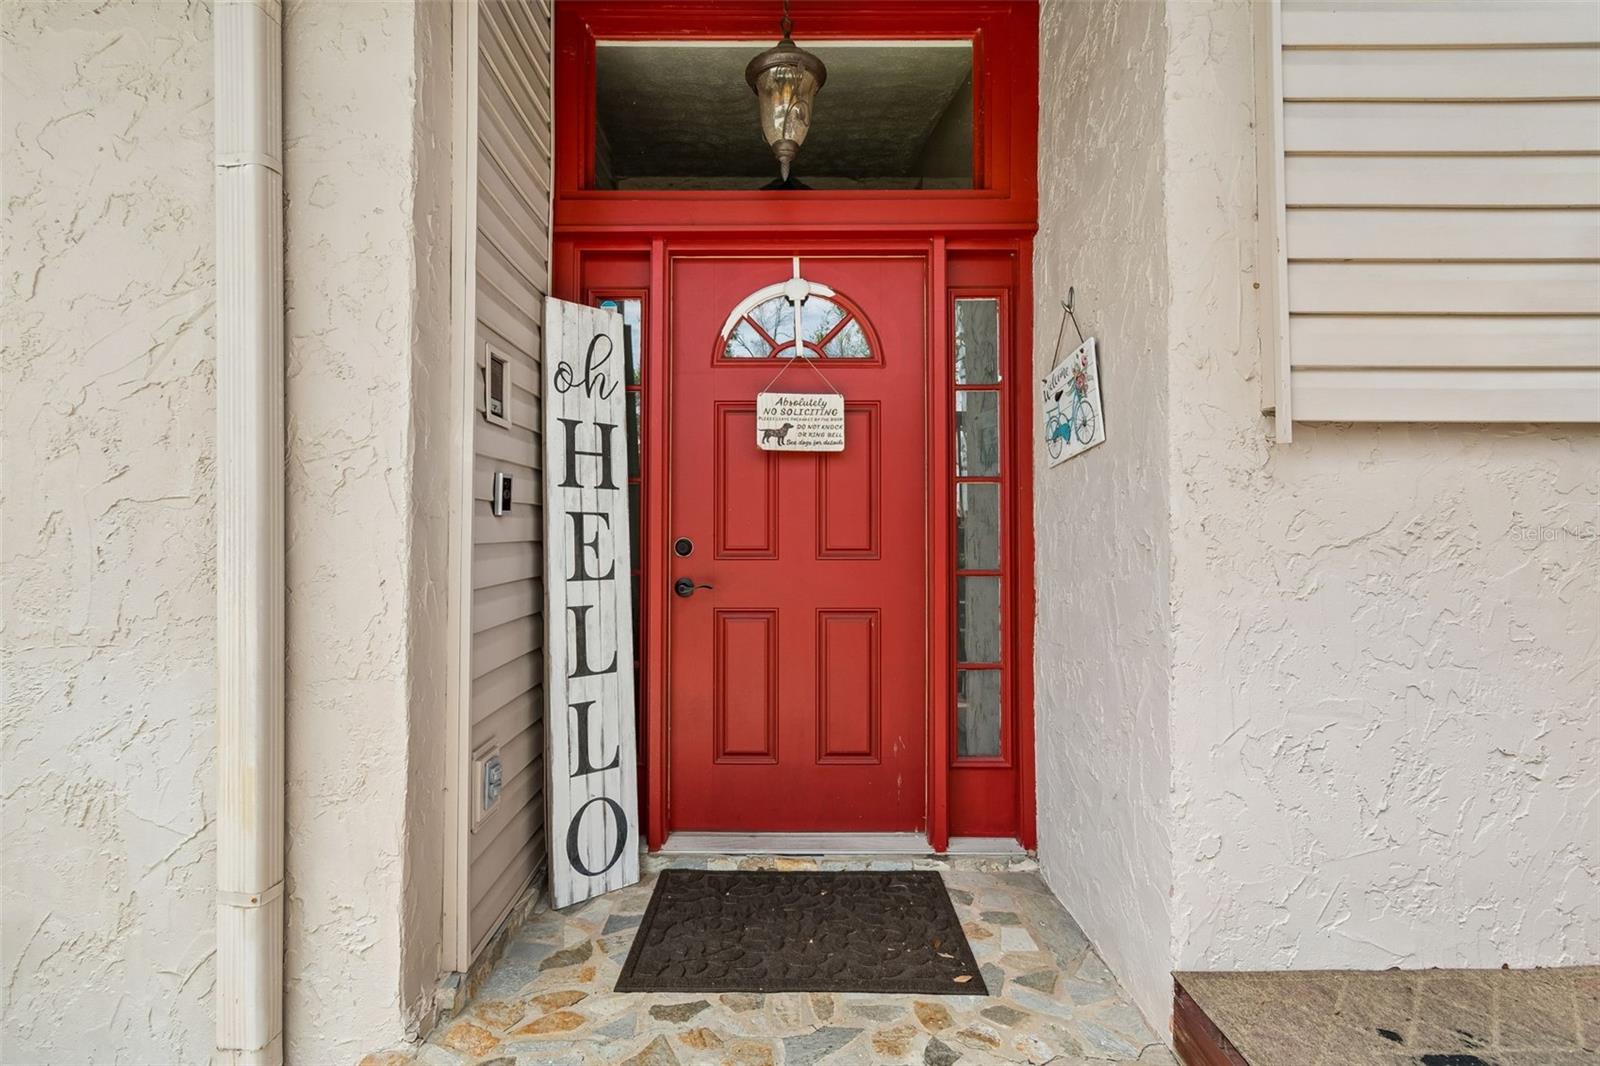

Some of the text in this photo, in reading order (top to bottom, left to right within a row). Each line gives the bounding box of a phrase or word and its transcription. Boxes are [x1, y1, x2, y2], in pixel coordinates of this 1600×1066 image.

[554, 333, 619, 400] oh
[763, 407, 838, 417] NO SOLICITING
[774, 397, 828, 407] Absolutely
[556, 417, 628, 877] HELLO
